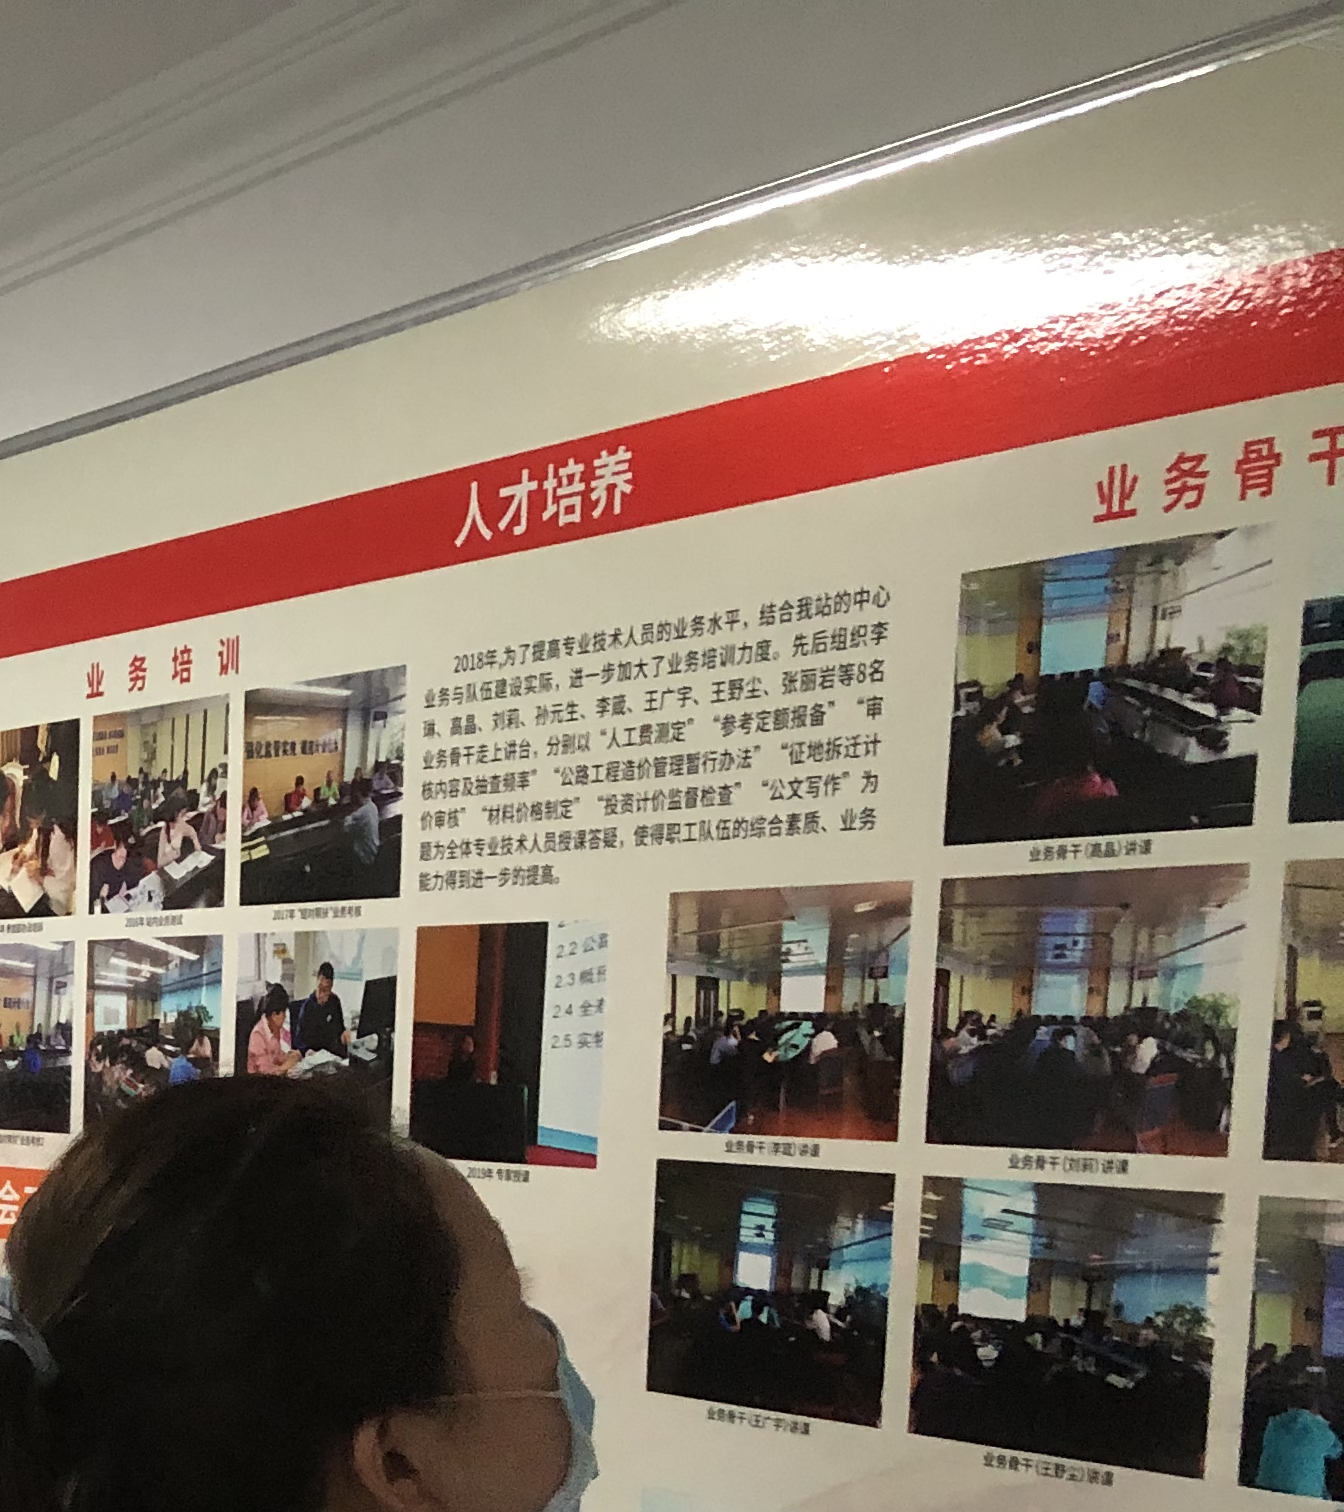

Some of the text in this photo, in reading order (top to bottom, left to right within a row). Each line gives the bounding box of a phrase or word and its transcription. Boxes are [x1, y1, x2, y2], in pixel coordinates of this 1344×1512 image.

[454, 445, 634, 548] 人才培养
[1093, 425, 1344, 524] 业务骨干
[86, 636, 240, 699] 业务培训
[418, 864, 560, 892] 能力得到进一步的提高。
